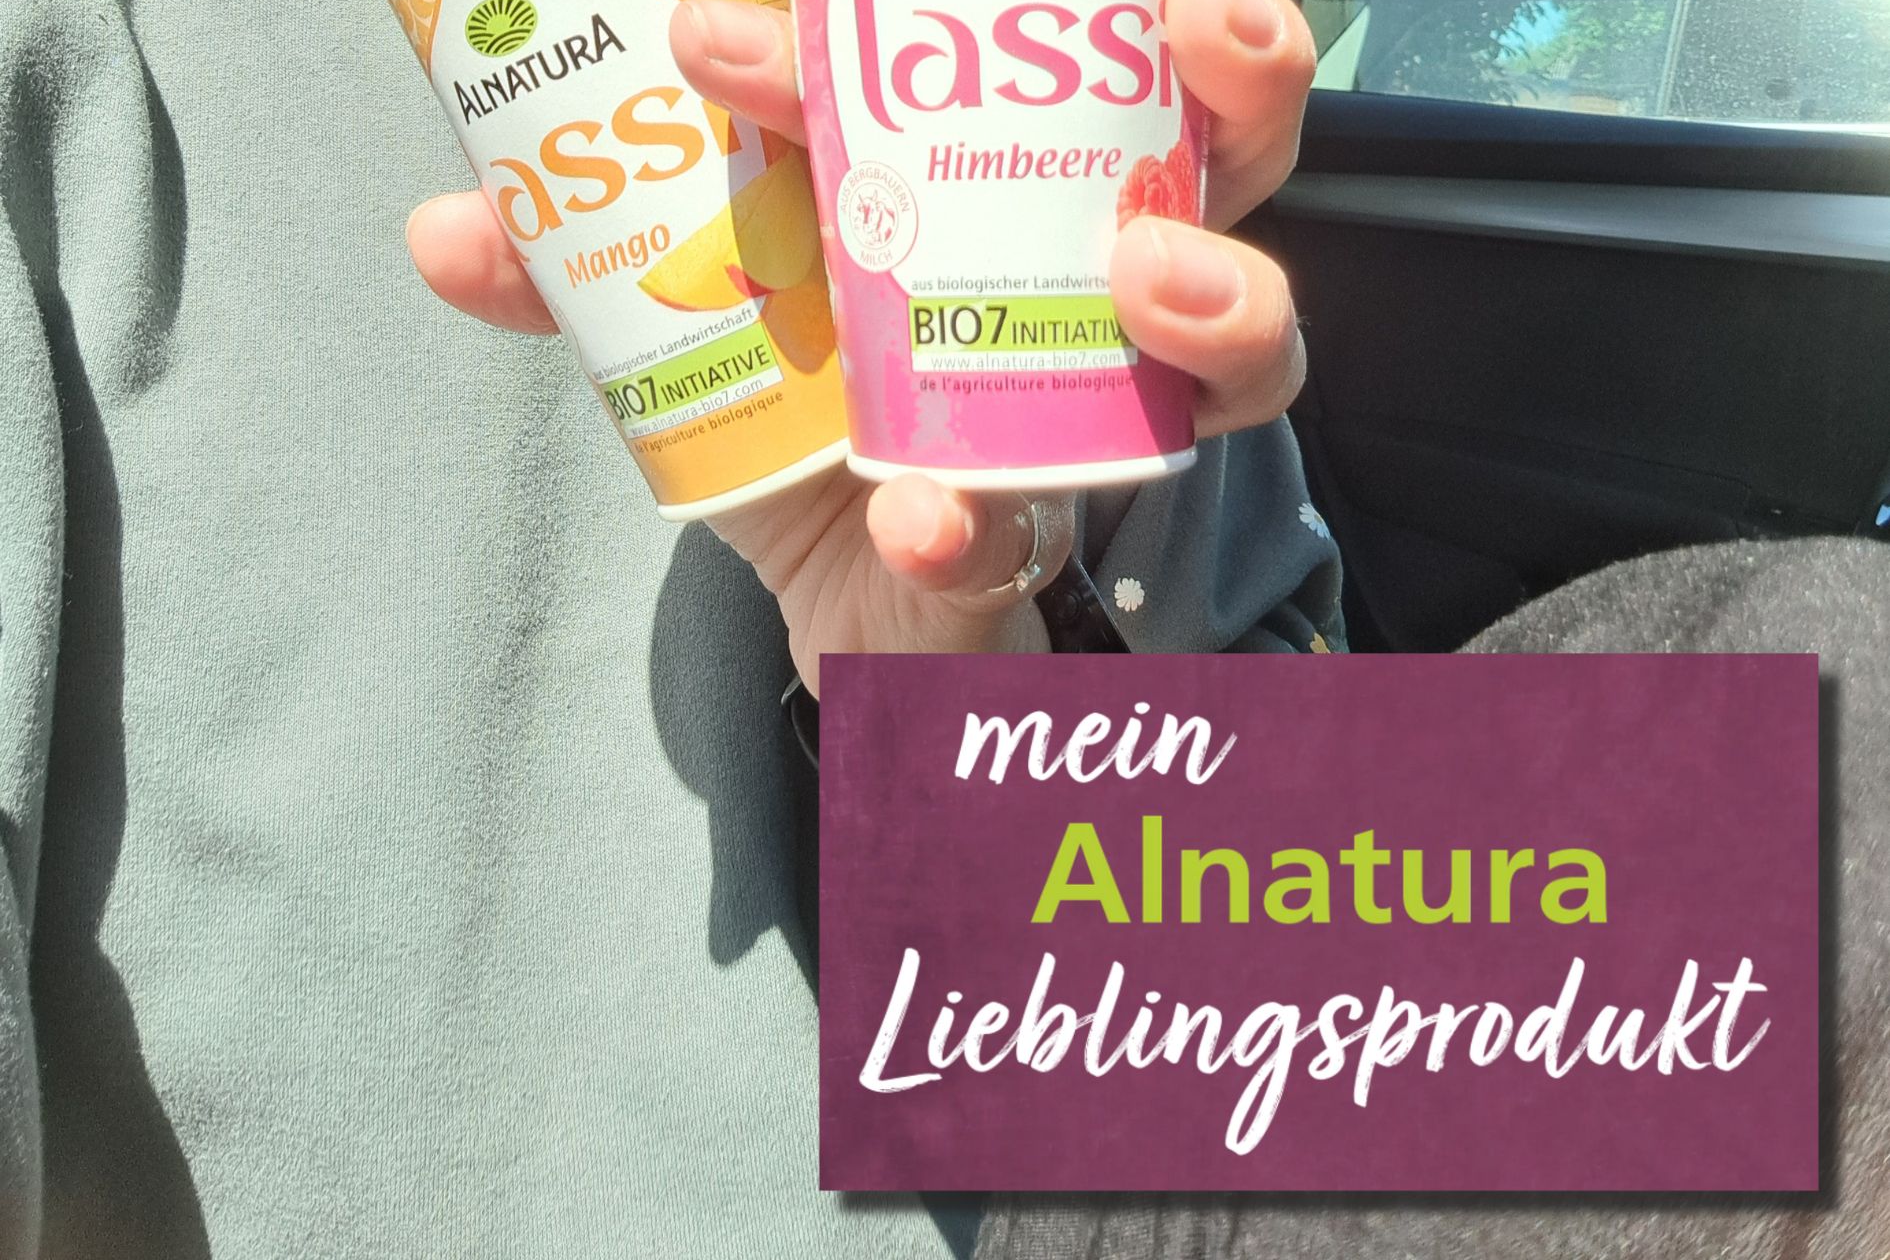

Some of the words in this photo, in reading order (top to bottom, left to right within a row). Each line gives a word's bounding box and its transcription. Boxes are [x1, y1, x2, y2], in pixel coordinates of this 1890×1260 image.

[453, 13, 627, 125] ALNATURA
[927, 141, 1122, 182] Himbeere
[848, 167, 911, 213] BERGBAUERN
[562, 223, 671, 289] Mango
[860, 249, 893, 266] MILCH
[911, 278, 934, 291] aus
[938, 274, 1029, 293] biologischer
[1034, 273, 1111, 290] Landwirts
[602, 349, 659, 378] biologischer
[660, 307, 754, 355] Landwirtschaft
[914, 304, 1008, 345] BIO7
[1012, 319, 1121, 345] INITIATIV
[604, 375, 659, 421] BIO7
[660, 343, 771, 405] INITIATIVE
[931, 351, 1121, 370] www.alnatura-bio7.com
[920, 378, 936, 391] de
[942, 376, 1045, 395] l'agriculture
[1052, 373, 1134, 392] biologique
[642, 424, 705, 453] l'agriculture
[709, 390, 784, 430] biologique
